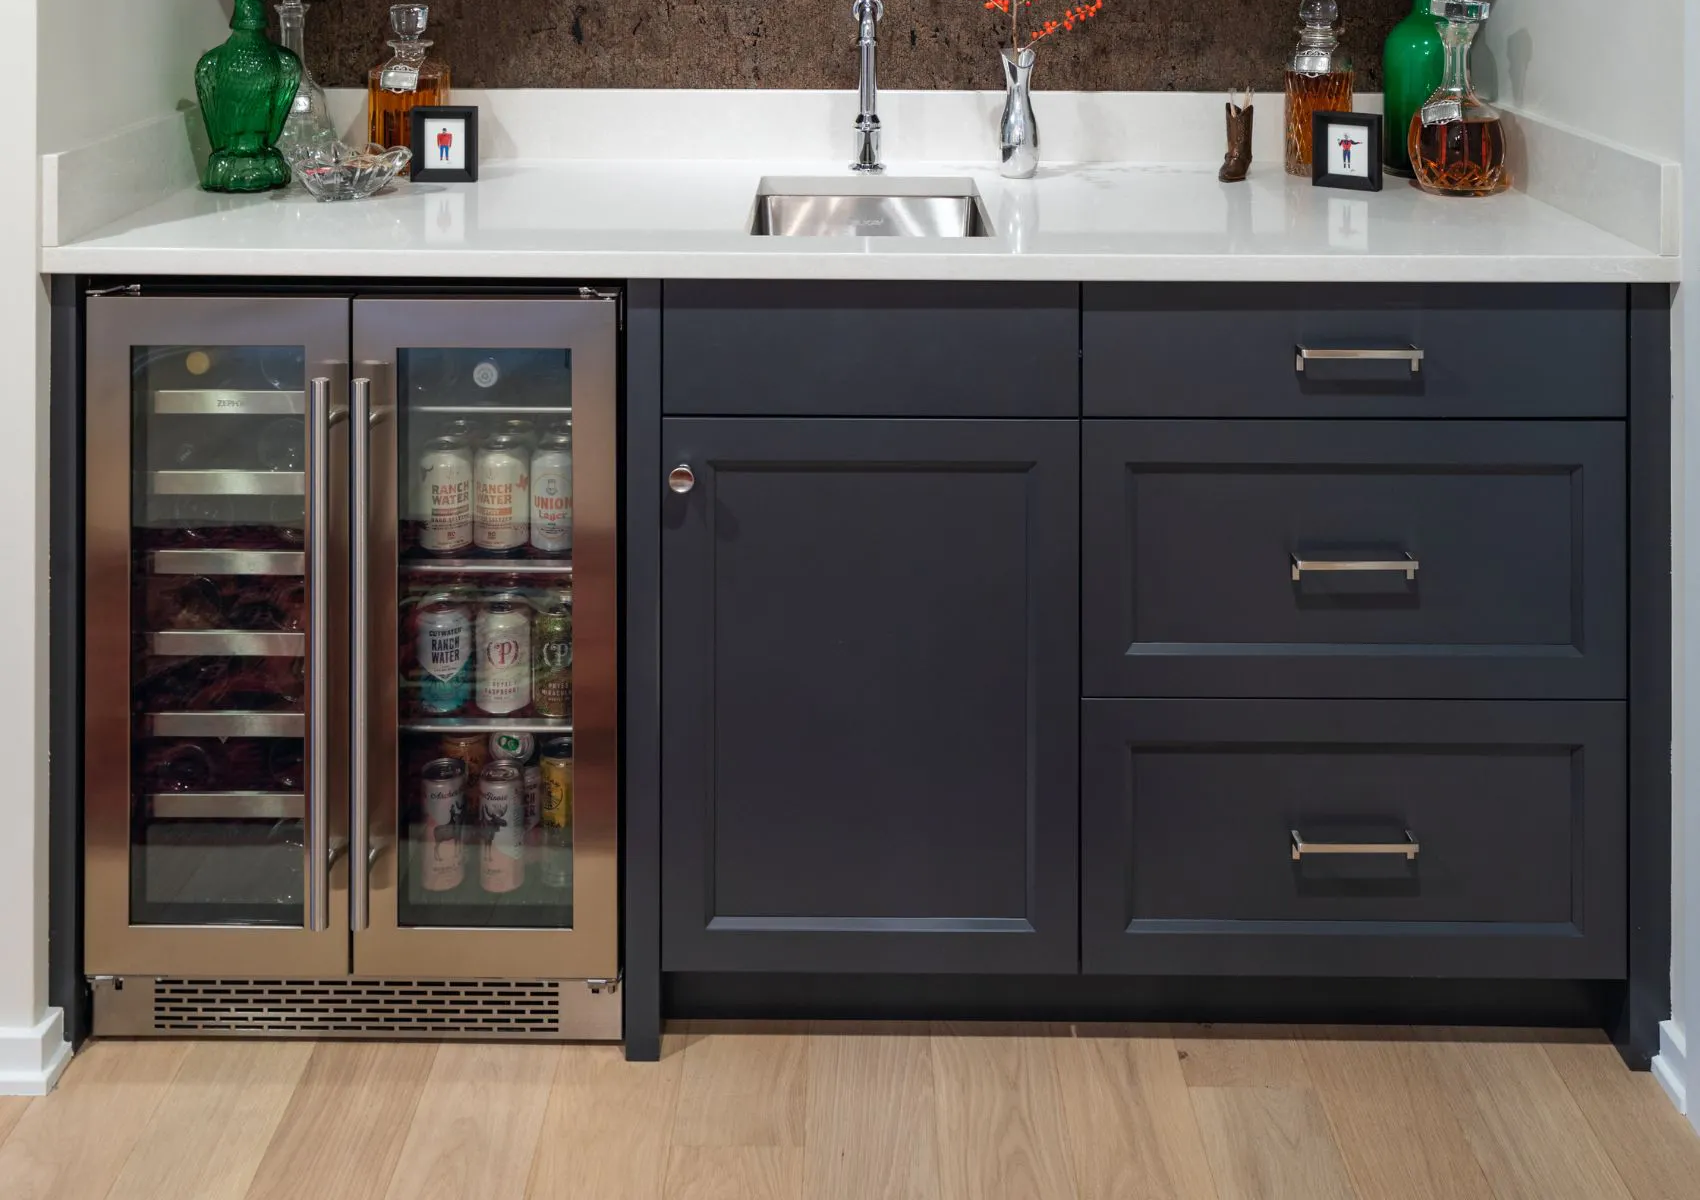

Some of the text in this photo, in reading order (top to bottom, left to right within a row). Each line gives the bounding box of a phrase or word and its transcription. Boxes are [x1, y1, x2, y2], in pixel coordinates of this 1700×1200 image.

[431, 480, 469, 495] RANCH
[476, 482, 512, 494] RANCH
[431, 492, 469, 505] WATER
[476, 492, 512, 505] WATER
[534, 495, 572, 510] UNION
[429, 627, 461, 637] CUTWATER
[431, 636, 459, 651] RANCH
[431, 649, 459, 664] WATER
